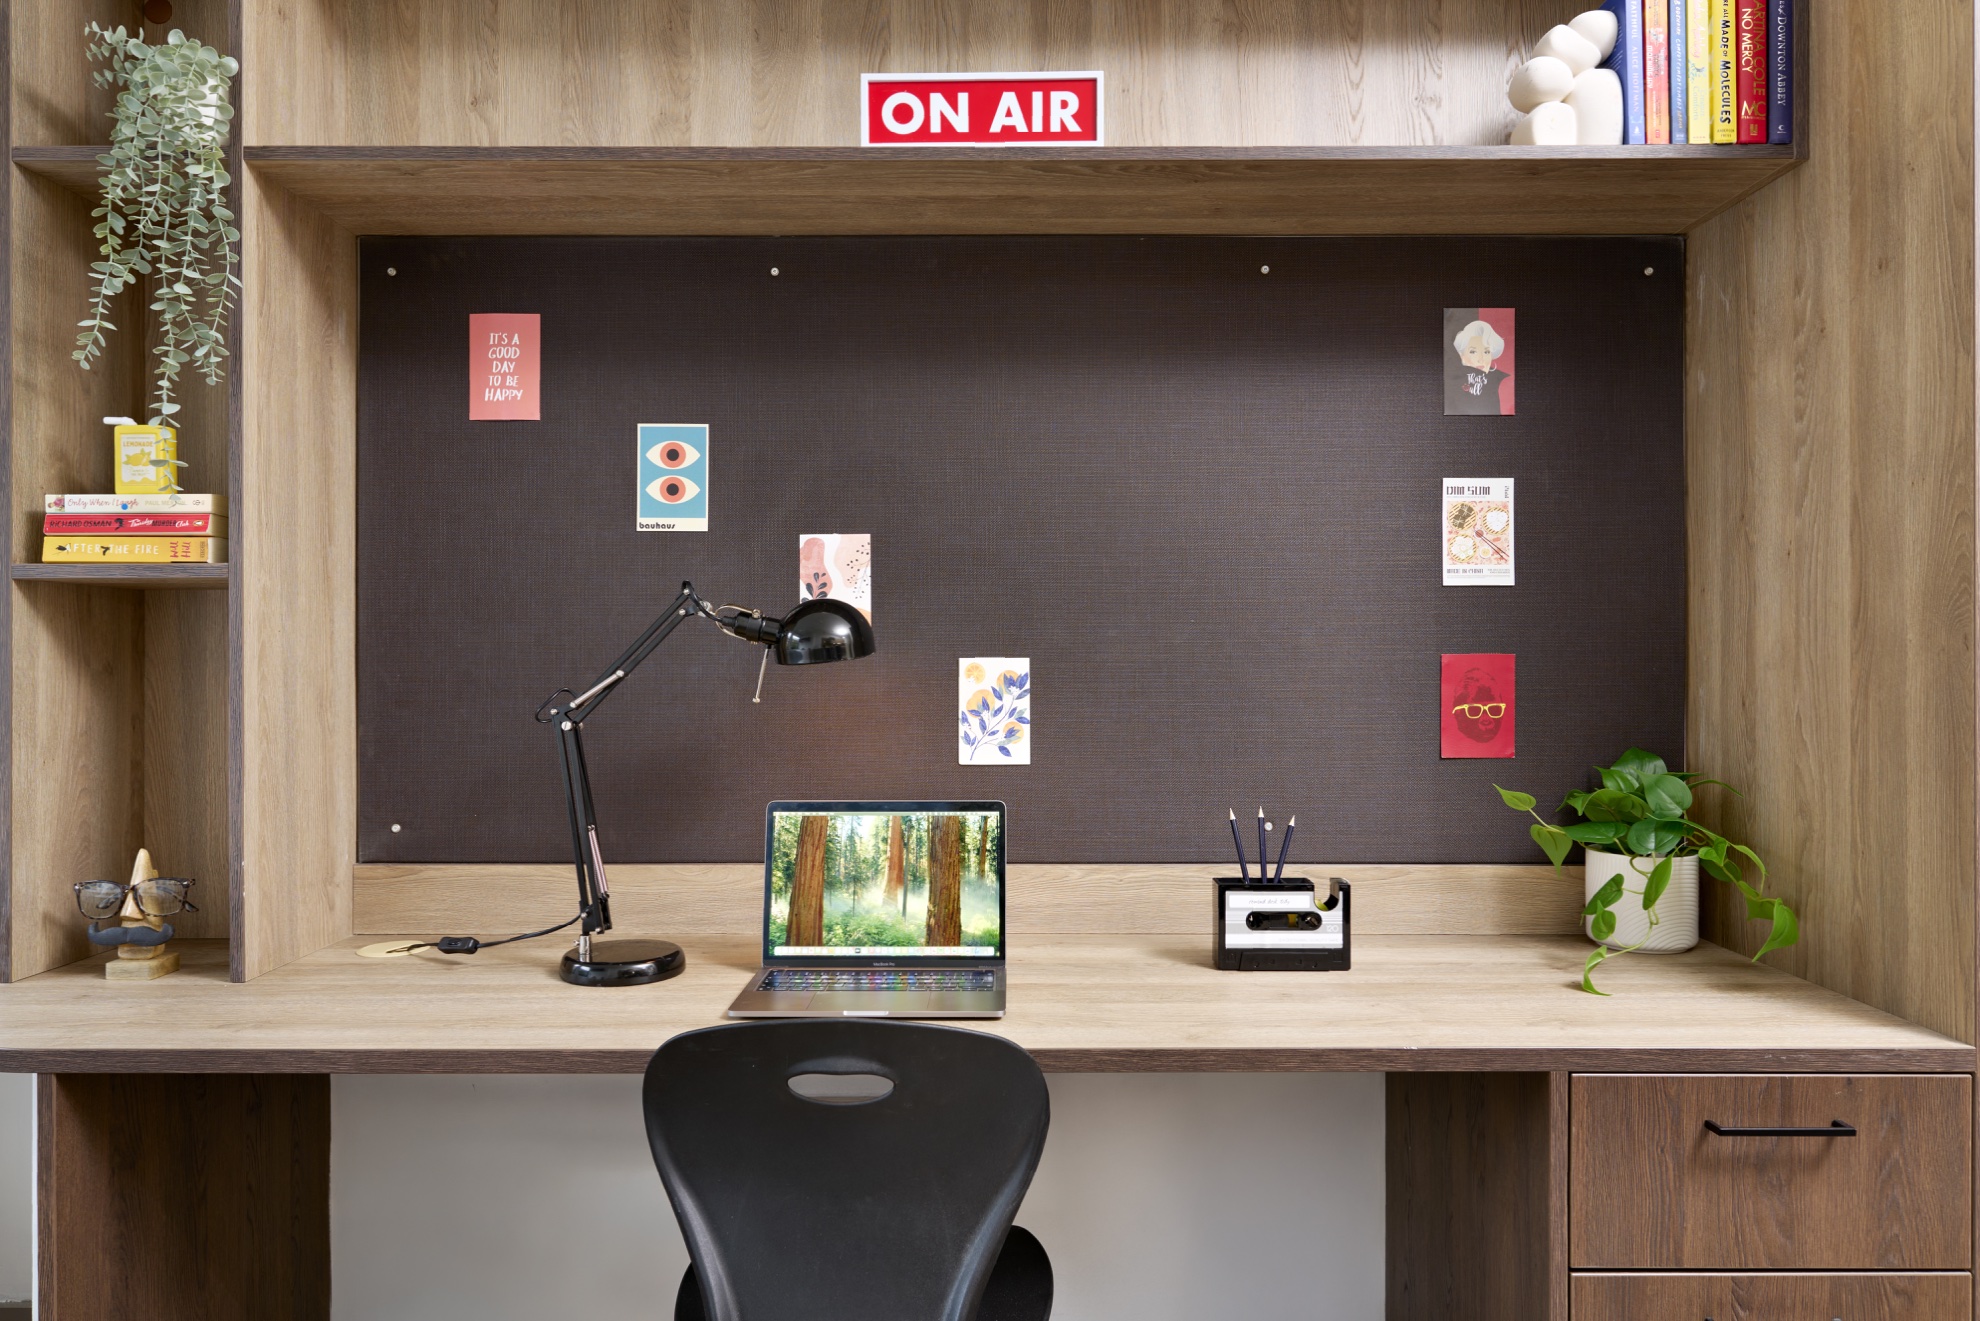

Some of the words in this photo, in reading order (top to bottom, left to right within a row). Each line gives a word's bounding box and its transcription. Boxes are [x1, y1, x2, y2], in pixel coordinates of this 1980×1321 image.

[1741, 8, 1754, 30] NO
[1720, 19, 1731, 49] MADE
[1777, 17, 1787, 71] DOWNTON
[1741, 33, 1754, 73] MERCY
[1753, 56, 1766, 96] COLE
[1719, 60, 1731, 125] MOLECULES
[1777, 73, 1787, 106] ABBEY
[881, 91, 970, 135] ON
[989, 91, 1082, 133] AIR
[489, 332, 508, 345] IT'S
[512, 333, 520, 345] A
[488, 346, 520, 359] GOOD
[492, 360, 516, 374] DAY
[488, 375, 501, 387] TO
[506, 375, 519, 387] BE
[1466, 373, 1488, 385] That's
[484, 388, 524, 402] HAPPY
[1469, 383, 1483, 396] all
[1446, 486, 1465, 495] DIM
[1467, 486, 1491, 495] SUM
[67, 496, 88, 509] Only
[89, 497, 111, 507] When
[83, 520, 112, 528] OSMAN
[639, 521, 676, 530] bauhaus
[65, 543, 101, 554] AFTER
[109, 543, 129, 554] THE
[135, 544, 159, 555] FIRE
